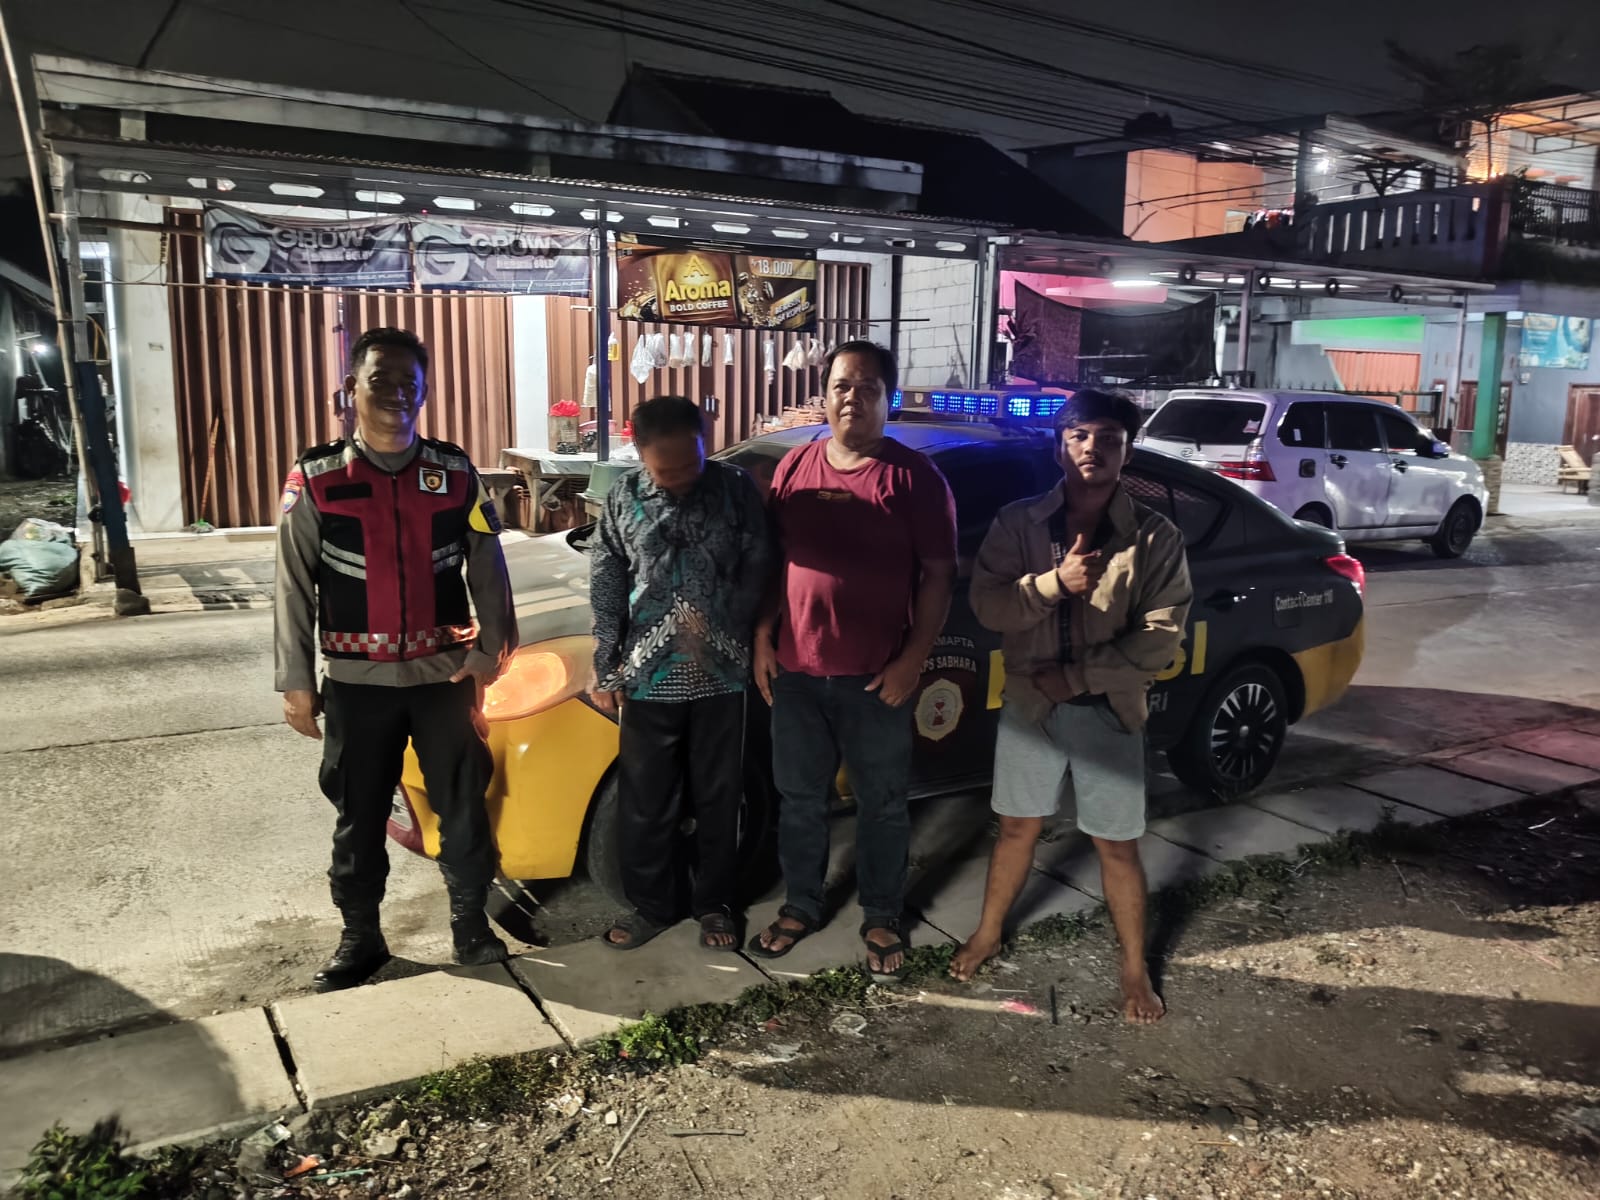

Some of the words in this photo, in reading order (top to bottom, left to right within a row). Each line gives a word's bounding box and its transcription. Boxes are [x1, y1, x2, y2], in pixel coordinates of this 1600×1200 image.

[665, 279, 731, 302] Aroma
[669, 302, 695, 313] BOLD
[696, 300, 729, 311] COFFEE
[936, 655, 977, 673] SABHARA
